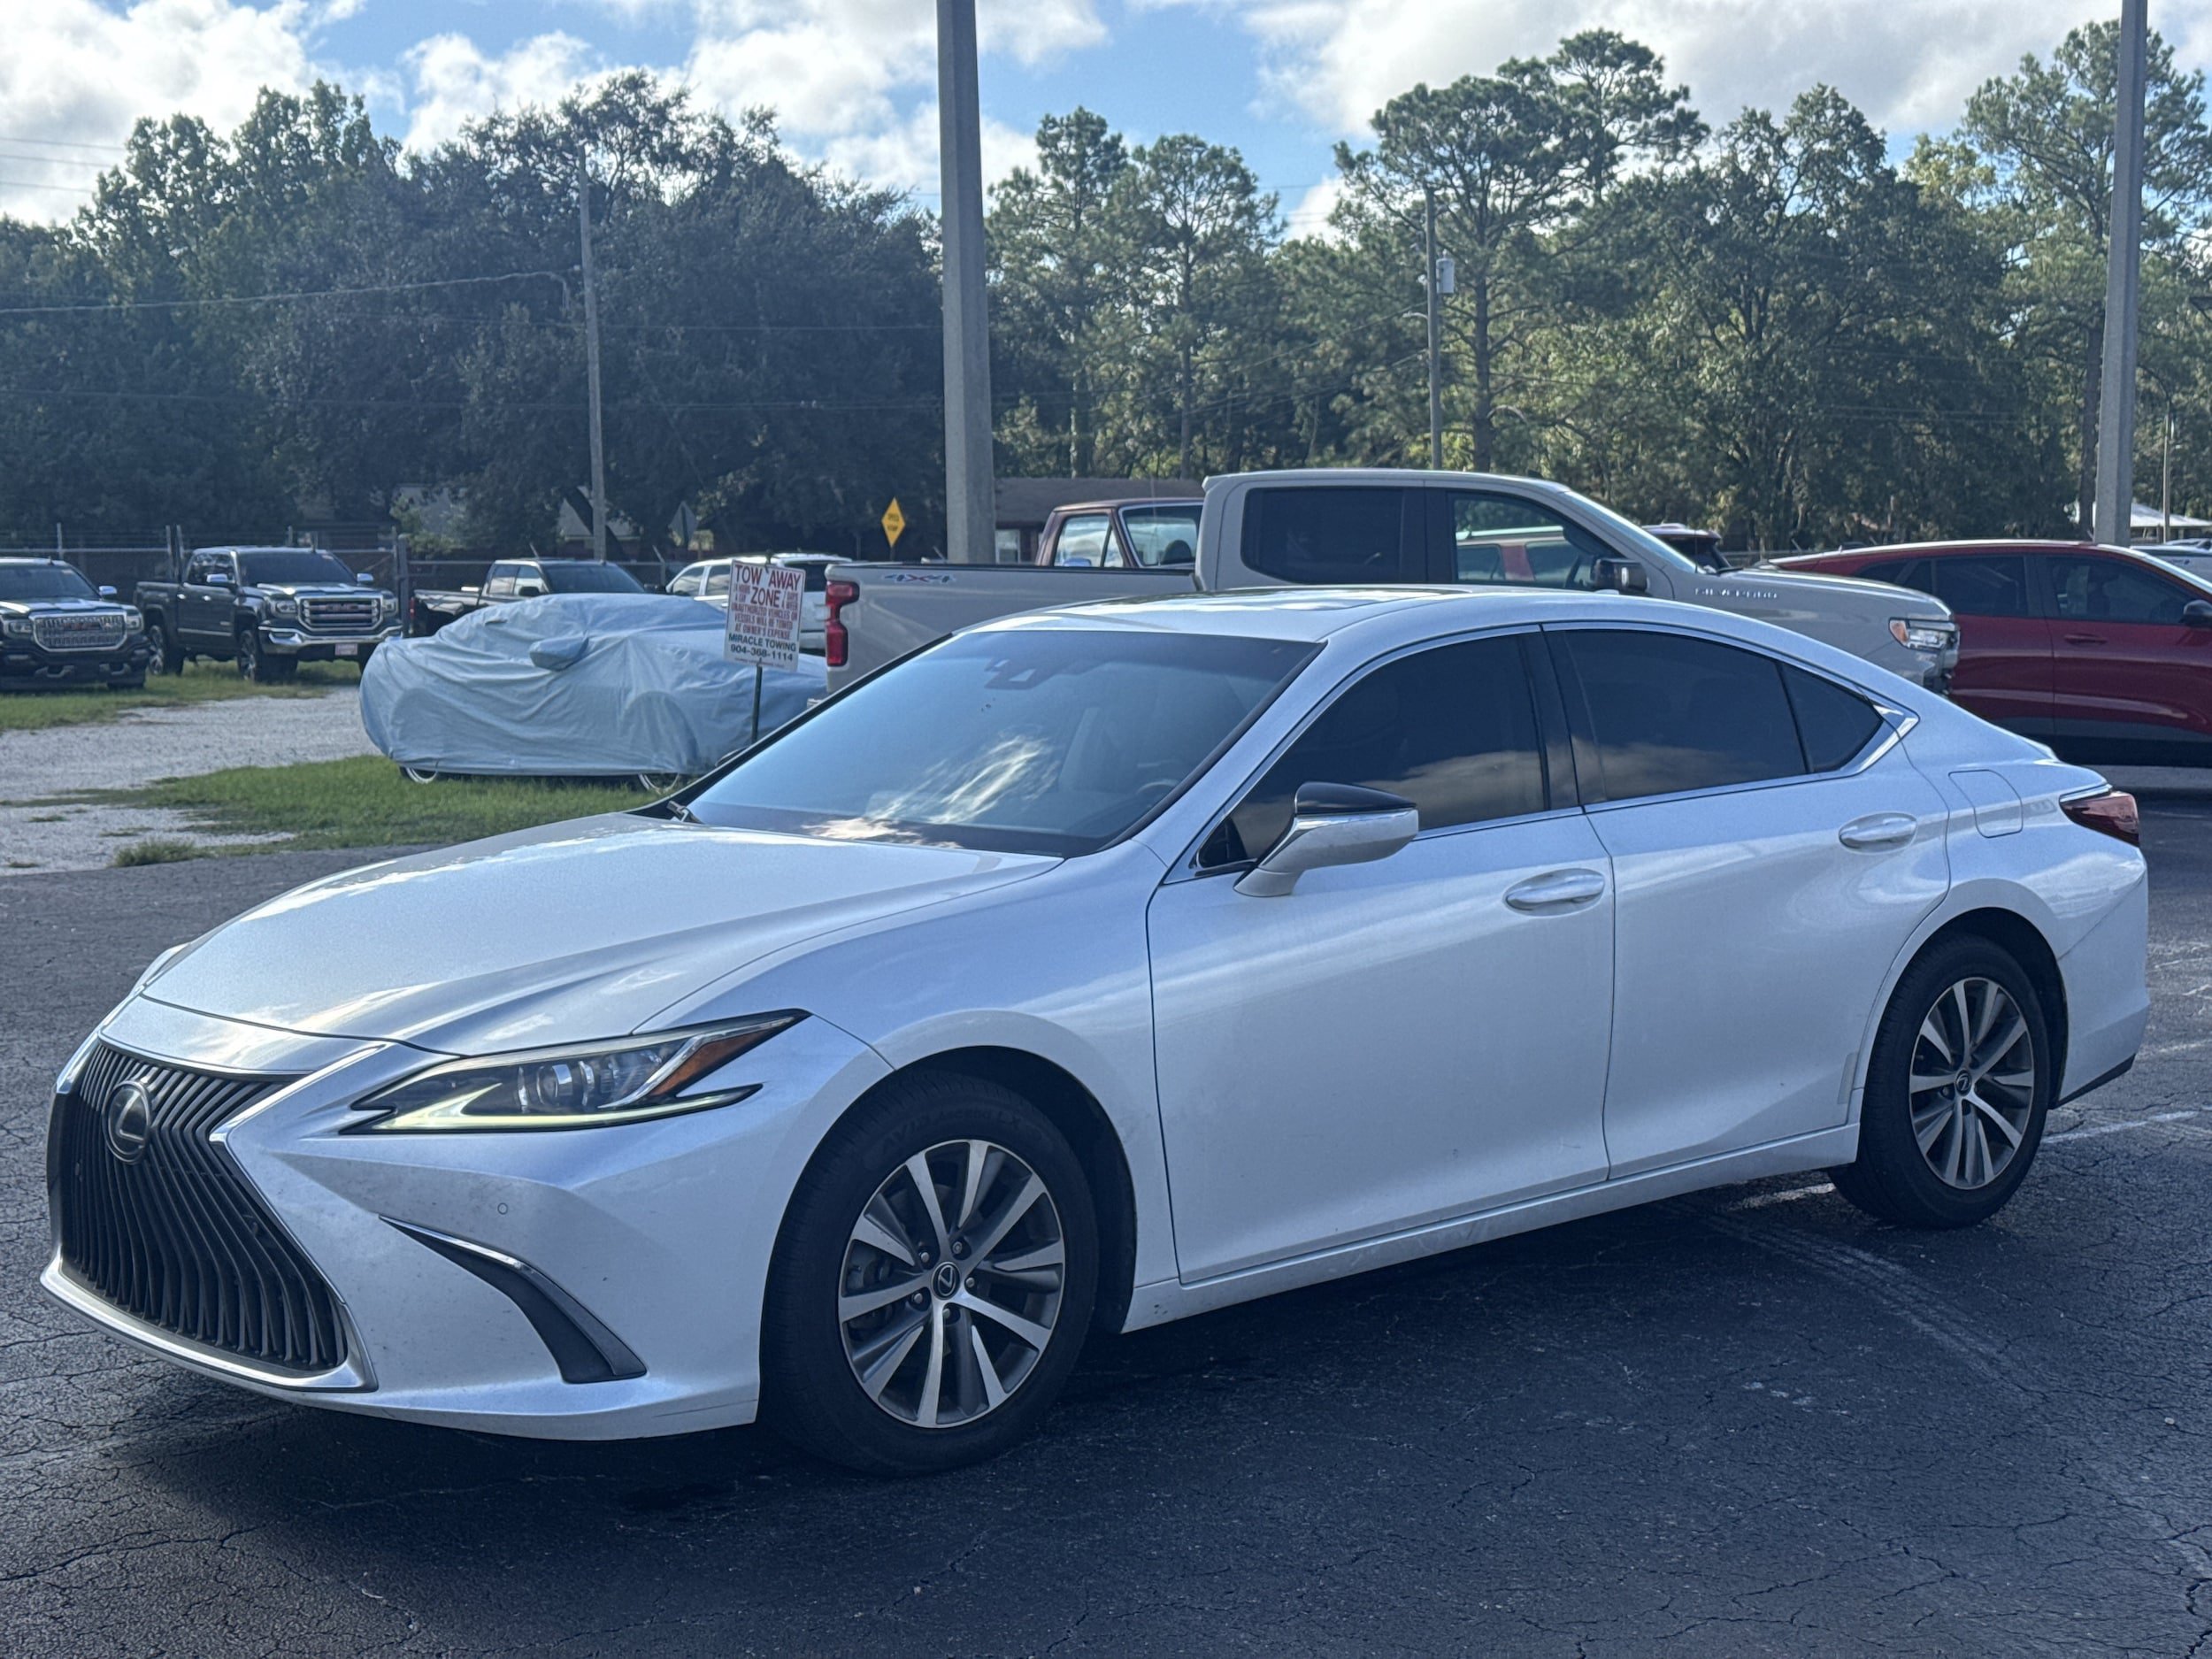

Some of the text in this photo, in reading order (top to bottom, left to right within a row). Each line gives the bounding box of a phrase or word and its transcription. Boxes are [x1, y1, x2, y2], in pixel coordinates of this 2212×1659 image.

[734, 565, 801, 591] TOW AWAY
[750, 587, 780, 607] ZONE
[729, 633, 796, 652] MIRACLE TOWING
